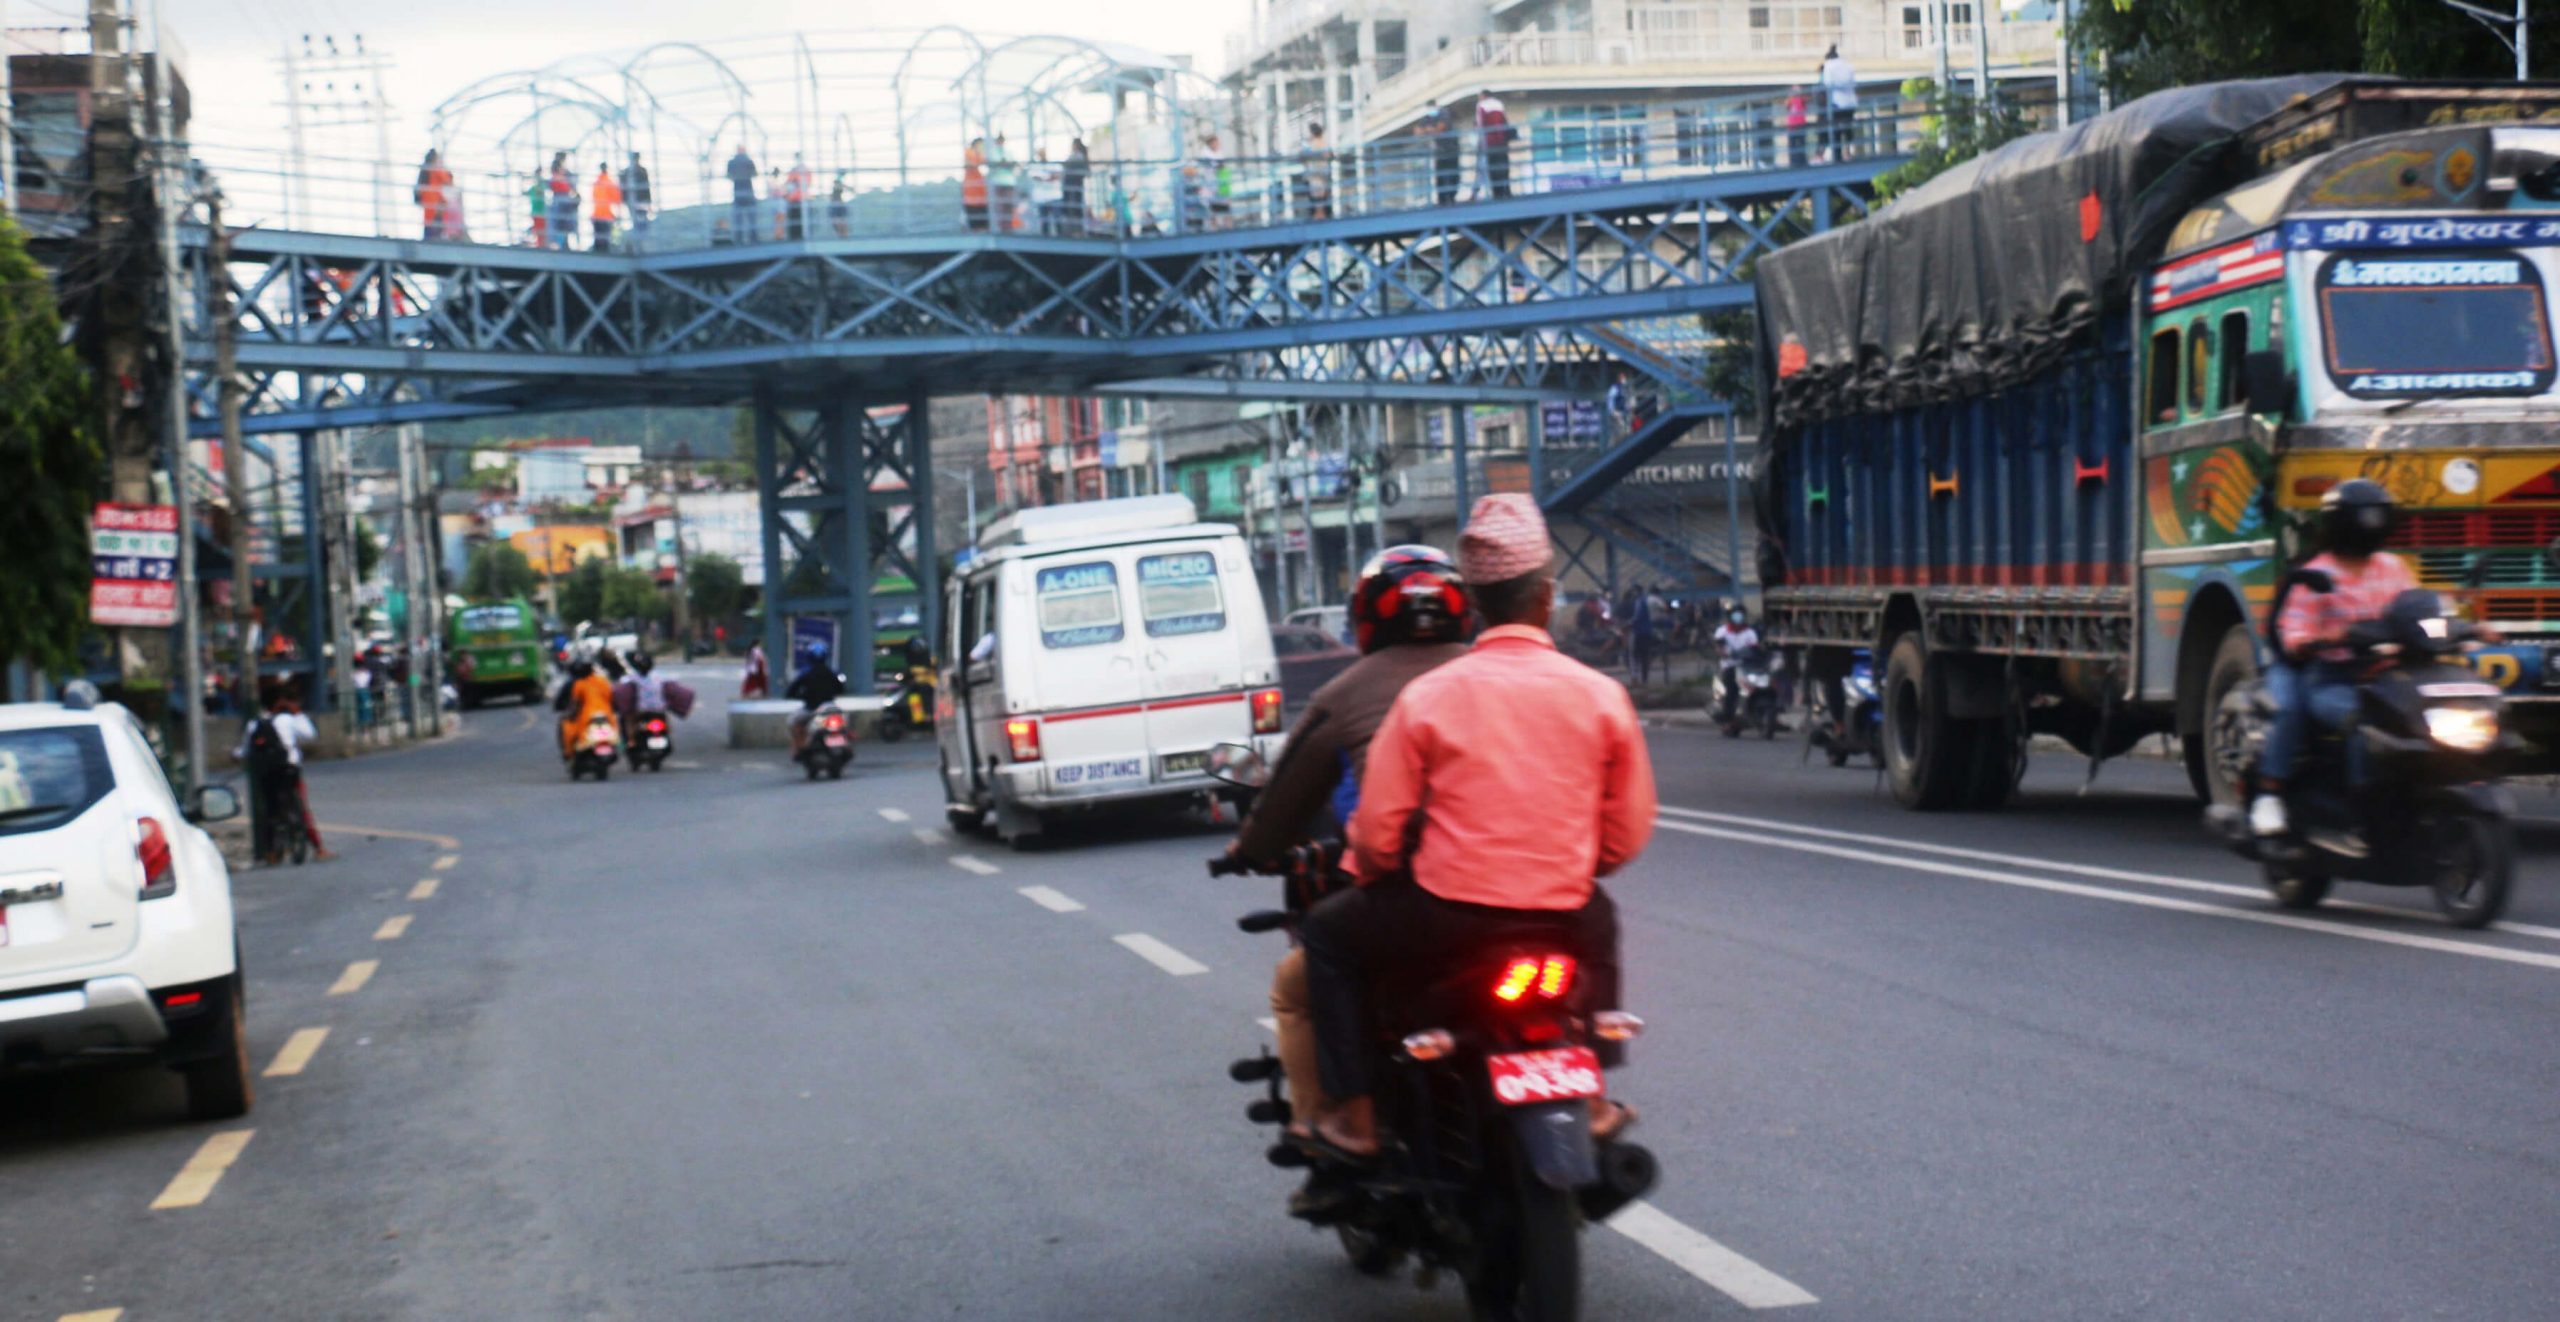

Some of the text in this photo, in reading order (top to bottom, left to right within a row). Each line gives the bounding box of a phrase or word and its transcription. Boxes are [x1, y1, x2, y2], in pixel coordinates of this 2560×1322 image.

[2321, 219, 2370, 243] श्री
[1043, 556, 1210, 591] A-ONE MICRO
[1055, 759, 1141, 783] KEEP DISTANCE
